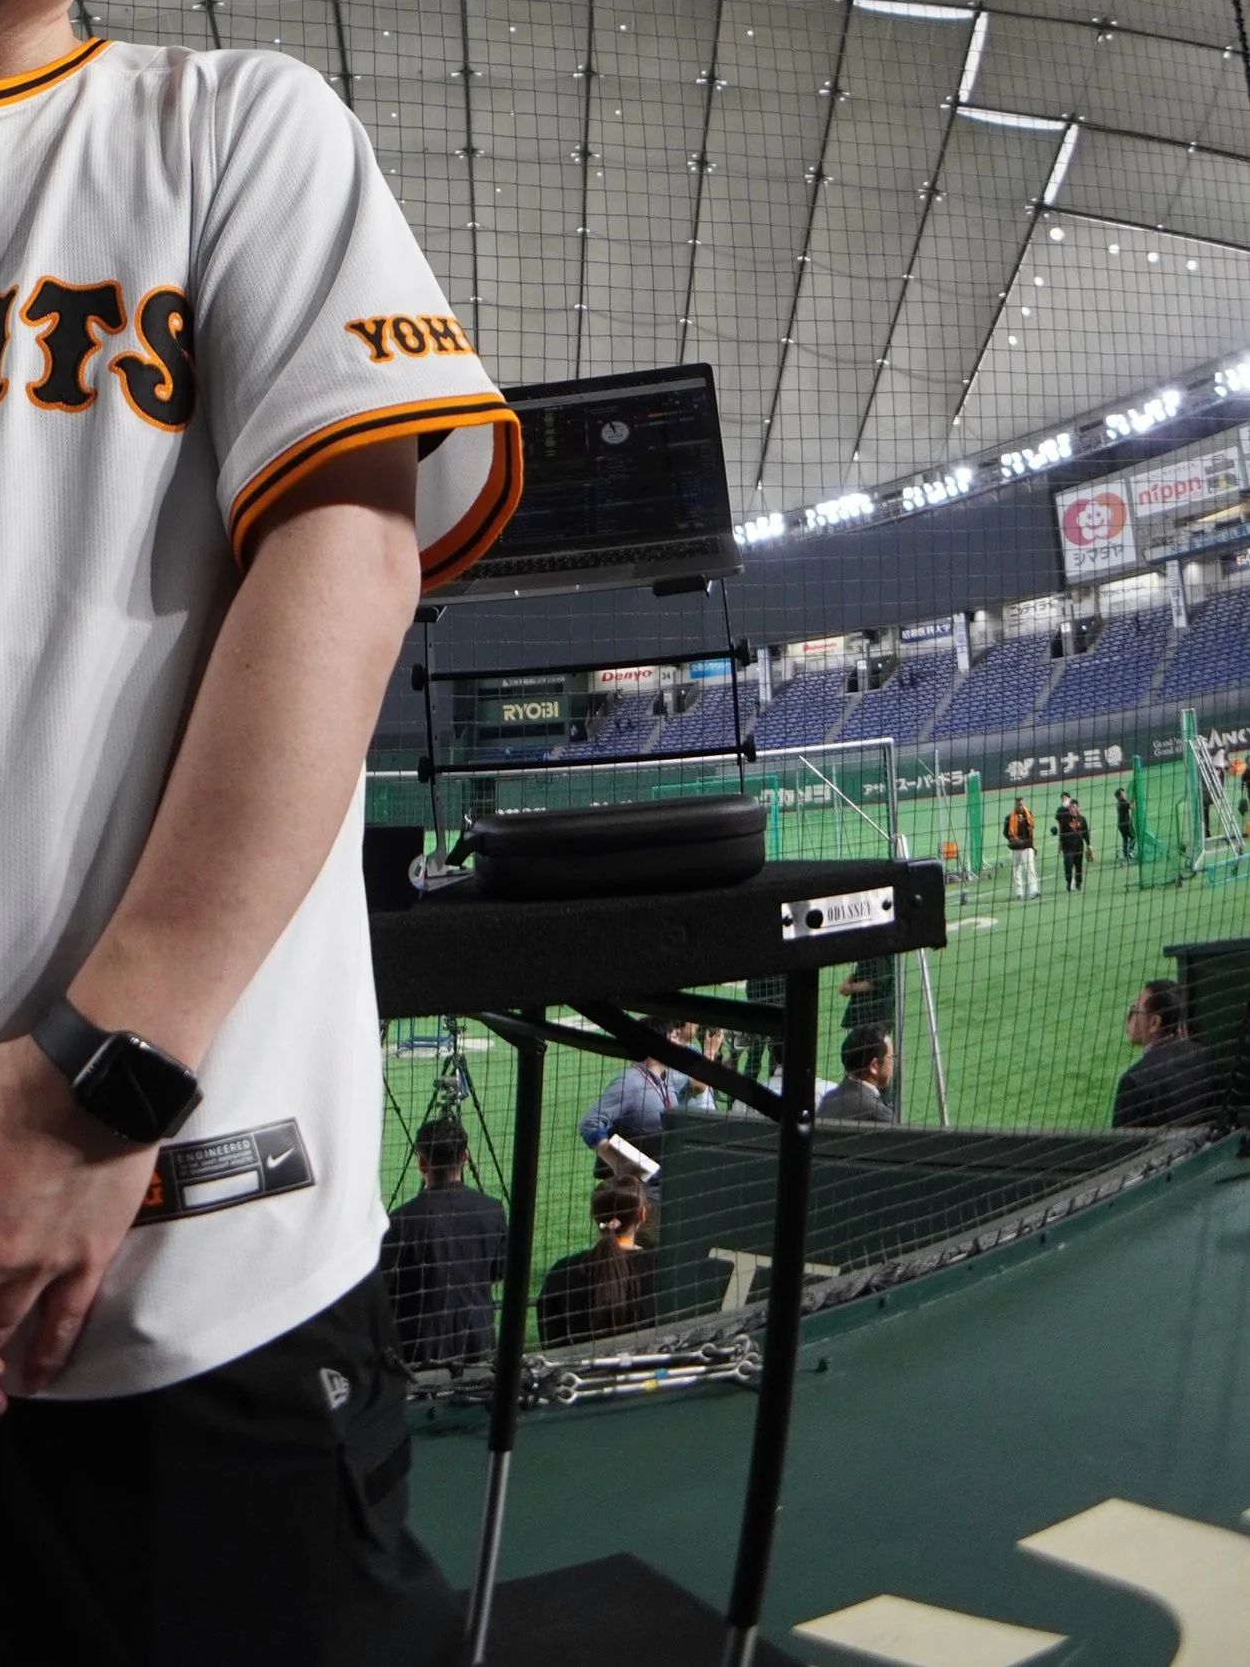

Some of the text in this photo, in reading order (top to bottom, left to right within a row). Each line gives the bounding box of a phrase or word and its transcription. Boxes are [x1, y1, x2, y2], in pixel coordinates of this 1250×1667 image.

[344, 313, 478, 363] YOM
[1137, 475, 1203, 506] nippn
[1073, 542, 1124, 567] シマダヤ
[601, 668, 653, 683] Denyo
[661, 671, 672, 682] 34
[502, 700, 560, 722] RYOBI
[827, 900, 872, 922] ODYSSEY
[178, 1140, 251, 1162] ENGINEERED
